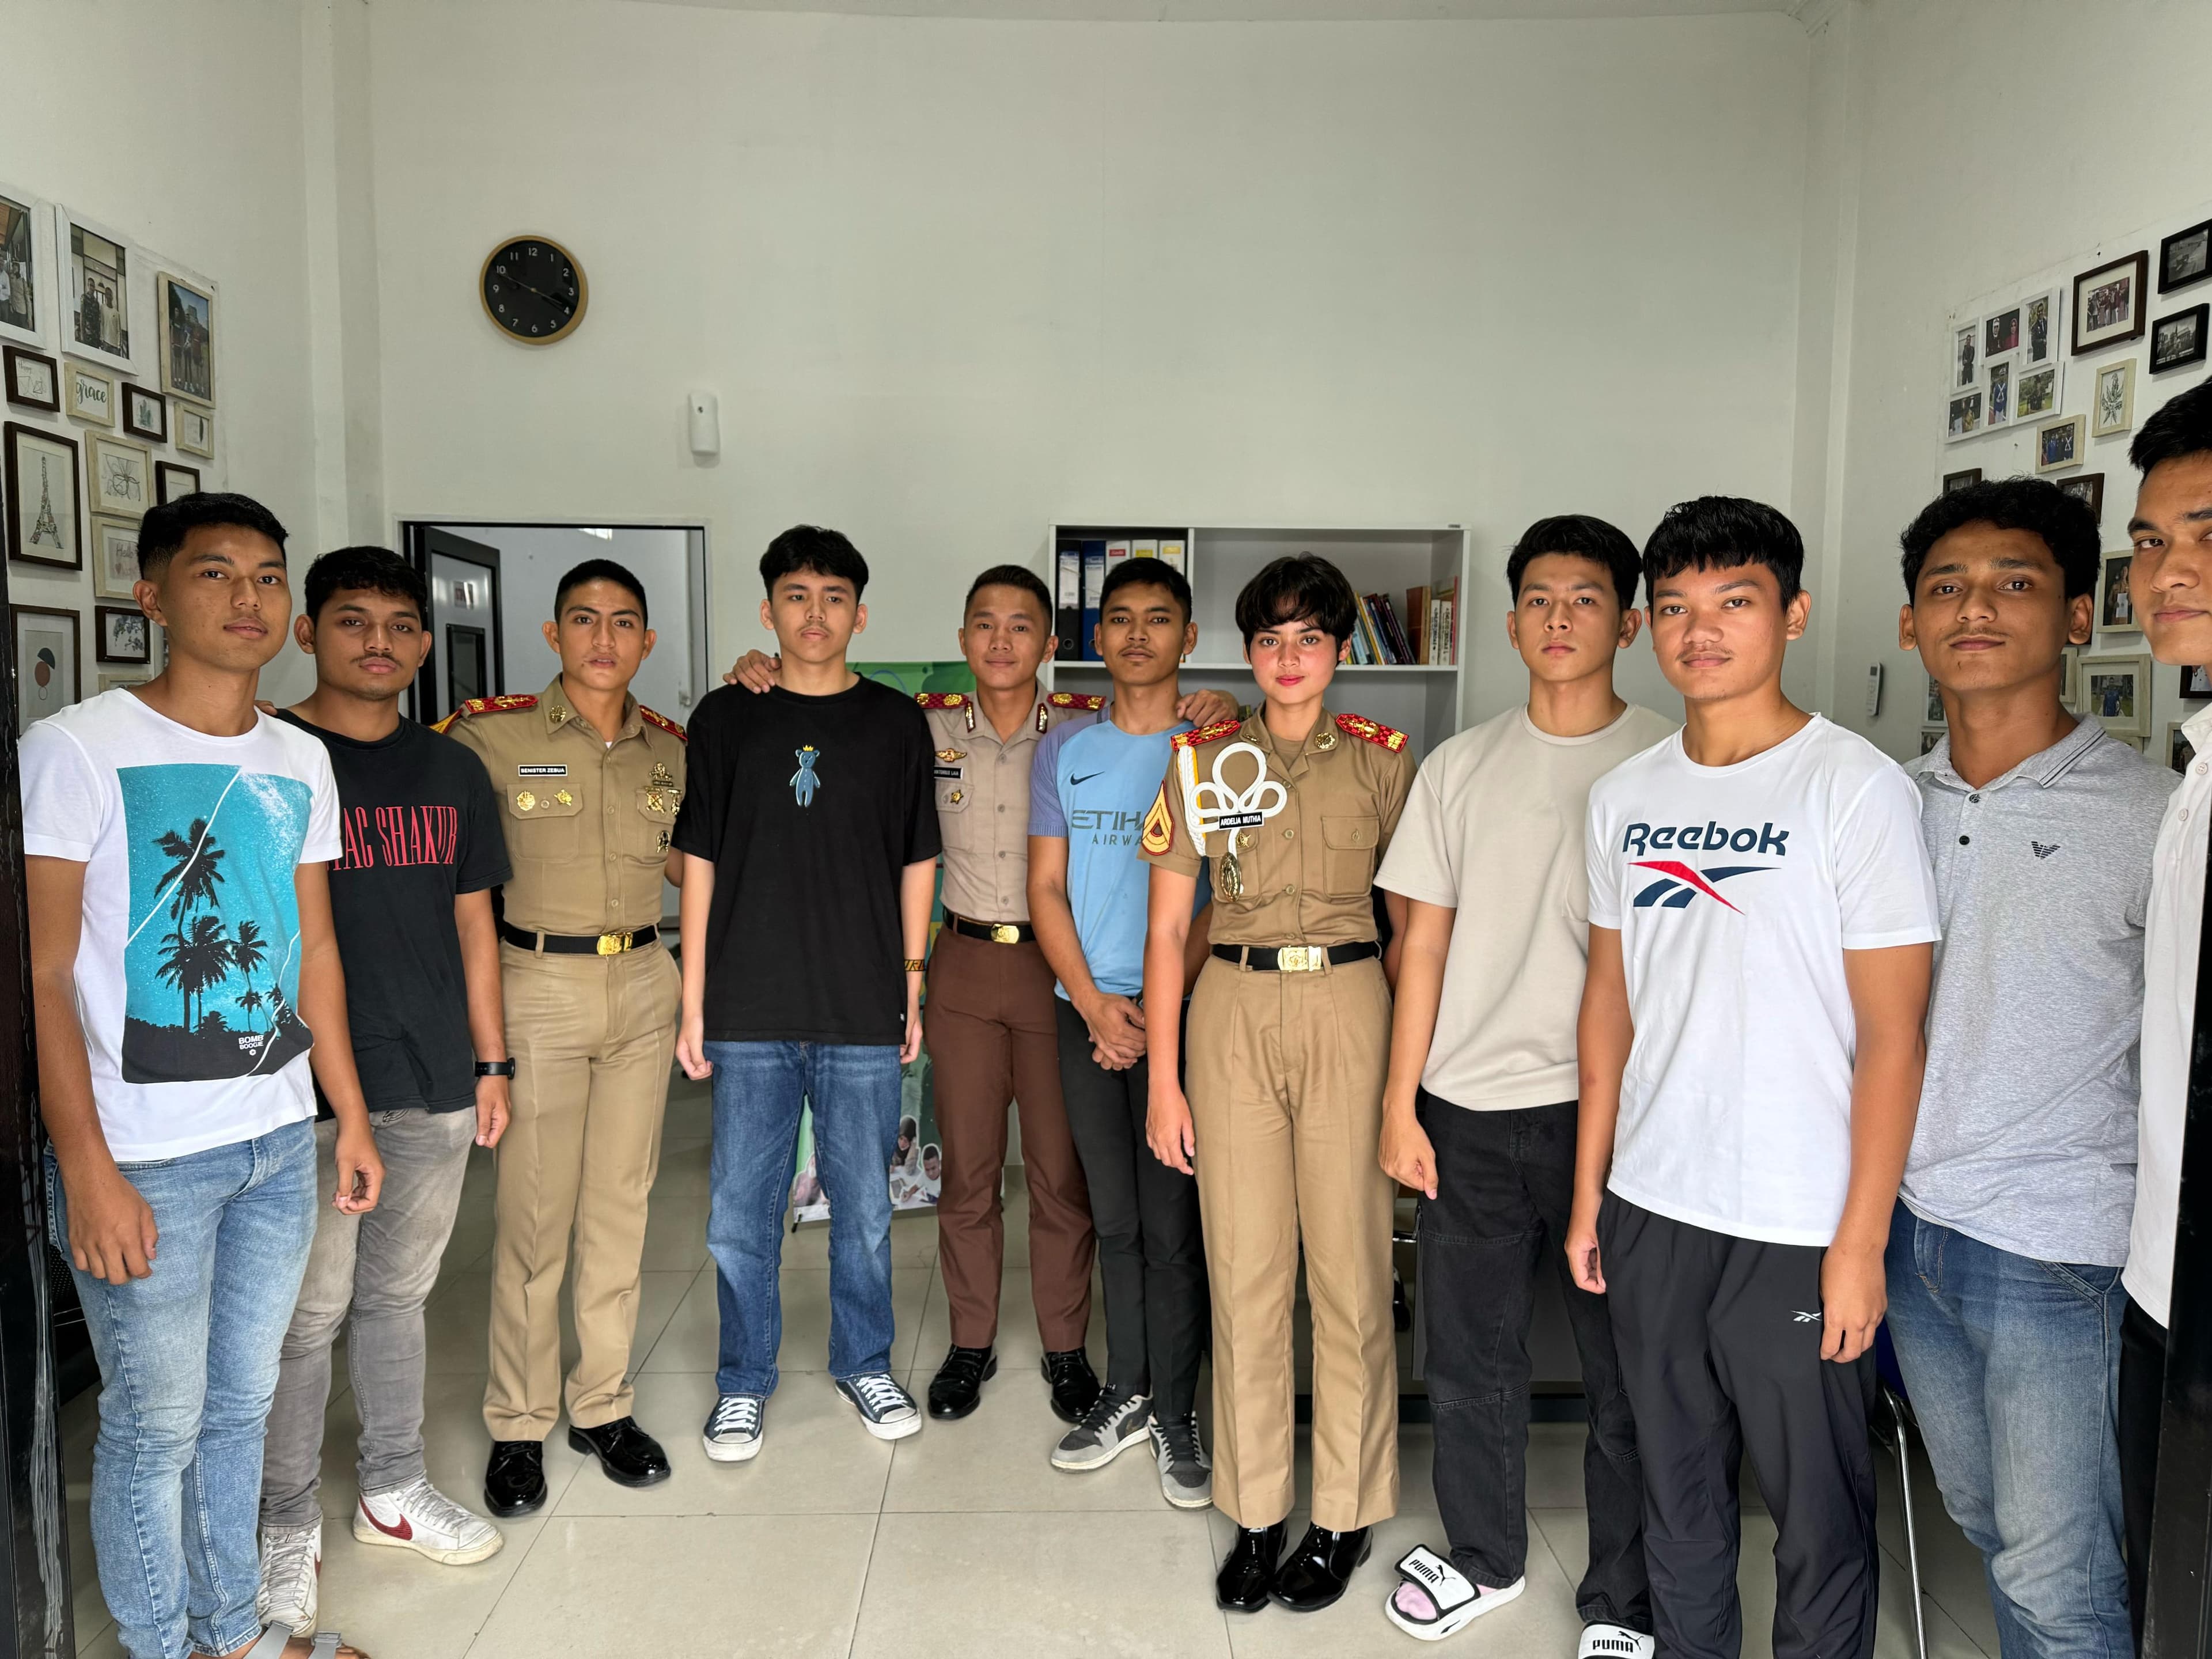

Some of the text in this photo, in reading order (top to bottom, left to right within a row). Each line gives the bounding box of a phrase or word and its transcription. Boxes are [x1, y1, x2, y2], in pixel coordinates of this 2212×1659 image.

[510, 252, 518, 261] 11
[528, 247, 538, 257] 12
[550, 253, 554, 262] 1
[496, 265, 506, 274] 10
[563, 268, 570, 277] 2
[493, 285, 499, 293] 9
[568, 287, 574, 296] 3
[498, 304, 505, 313] 8
[563, 306, 570, 315] 4
[512, 319, 518, 327] 7
[550, 320, 556, 328] 5
[531, 324, 538, 333] 6
[75, 378, 107, 404] grace
[1071, 809, 1144, 831] ETIH
[1220, 817, 1241, 826] ARDELIA
[327, 806, 374, 870] AC
[1622, 821, 1789, 857] Reebok
[238, 1035, 264, 1045] BOMB
[1408, 1559, 1440, 1584] PUMA
[1592, 1639, 1634, 1653] PUMA
